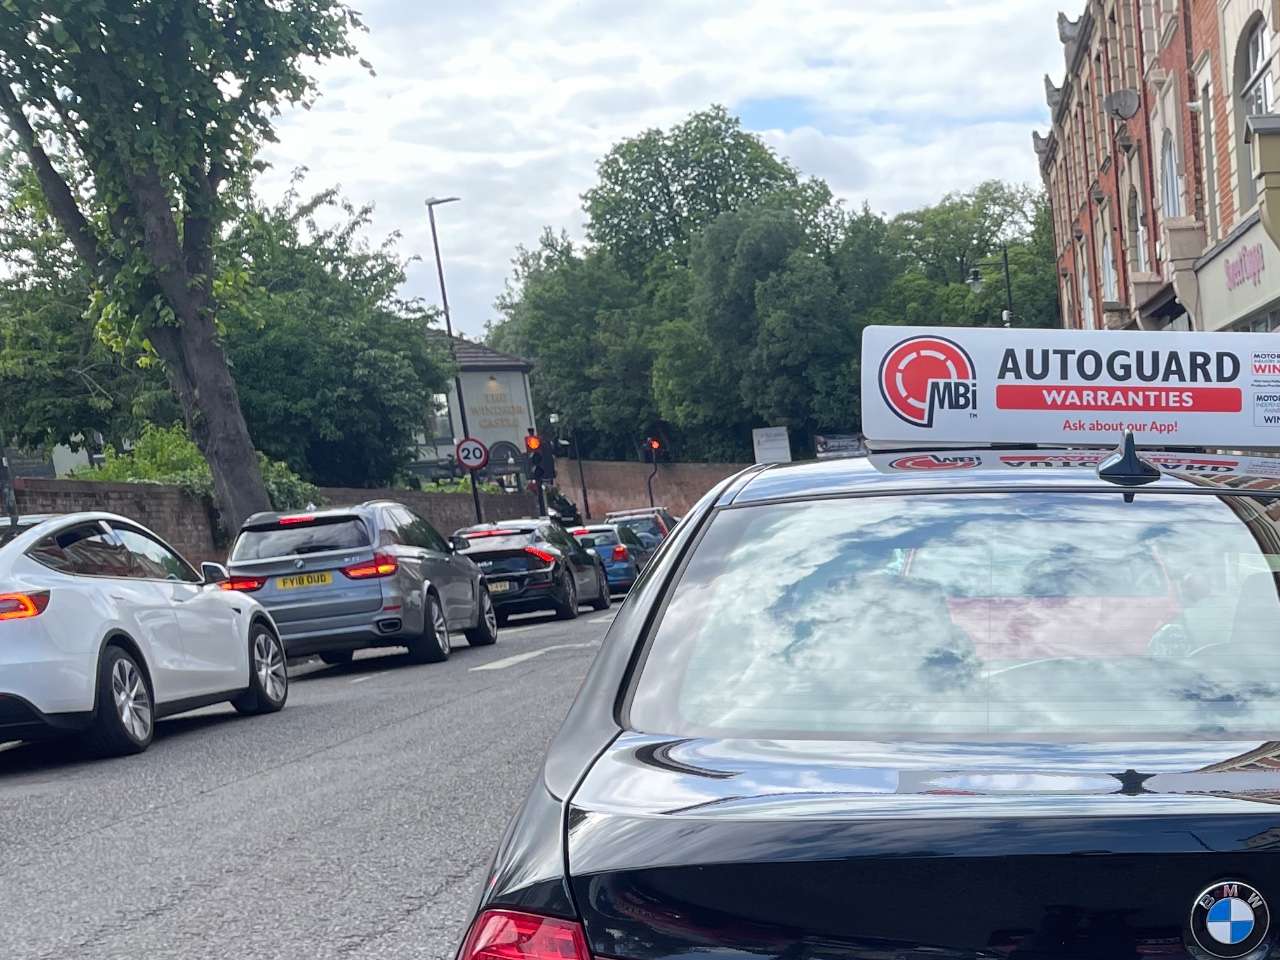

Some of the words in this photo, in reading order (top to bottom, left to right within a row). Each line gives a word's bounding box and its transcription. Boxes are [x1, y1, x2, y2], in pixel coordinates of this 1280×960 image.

[997, 348, 1241, 383] AUTOGUARD
[928, 382, 977, 428] MBi
[1042, 389, 1194, 408] WARRANTIES
[1063, 419, 1086, 432] Ask
[1089, 420, 1124, 432] about
[1126, 423, 1147, 433] our
[1150, 420, 1178, 434] App!
[461, 447, 483, 460] 20
[1200, 884, 1263, 910] BMW
